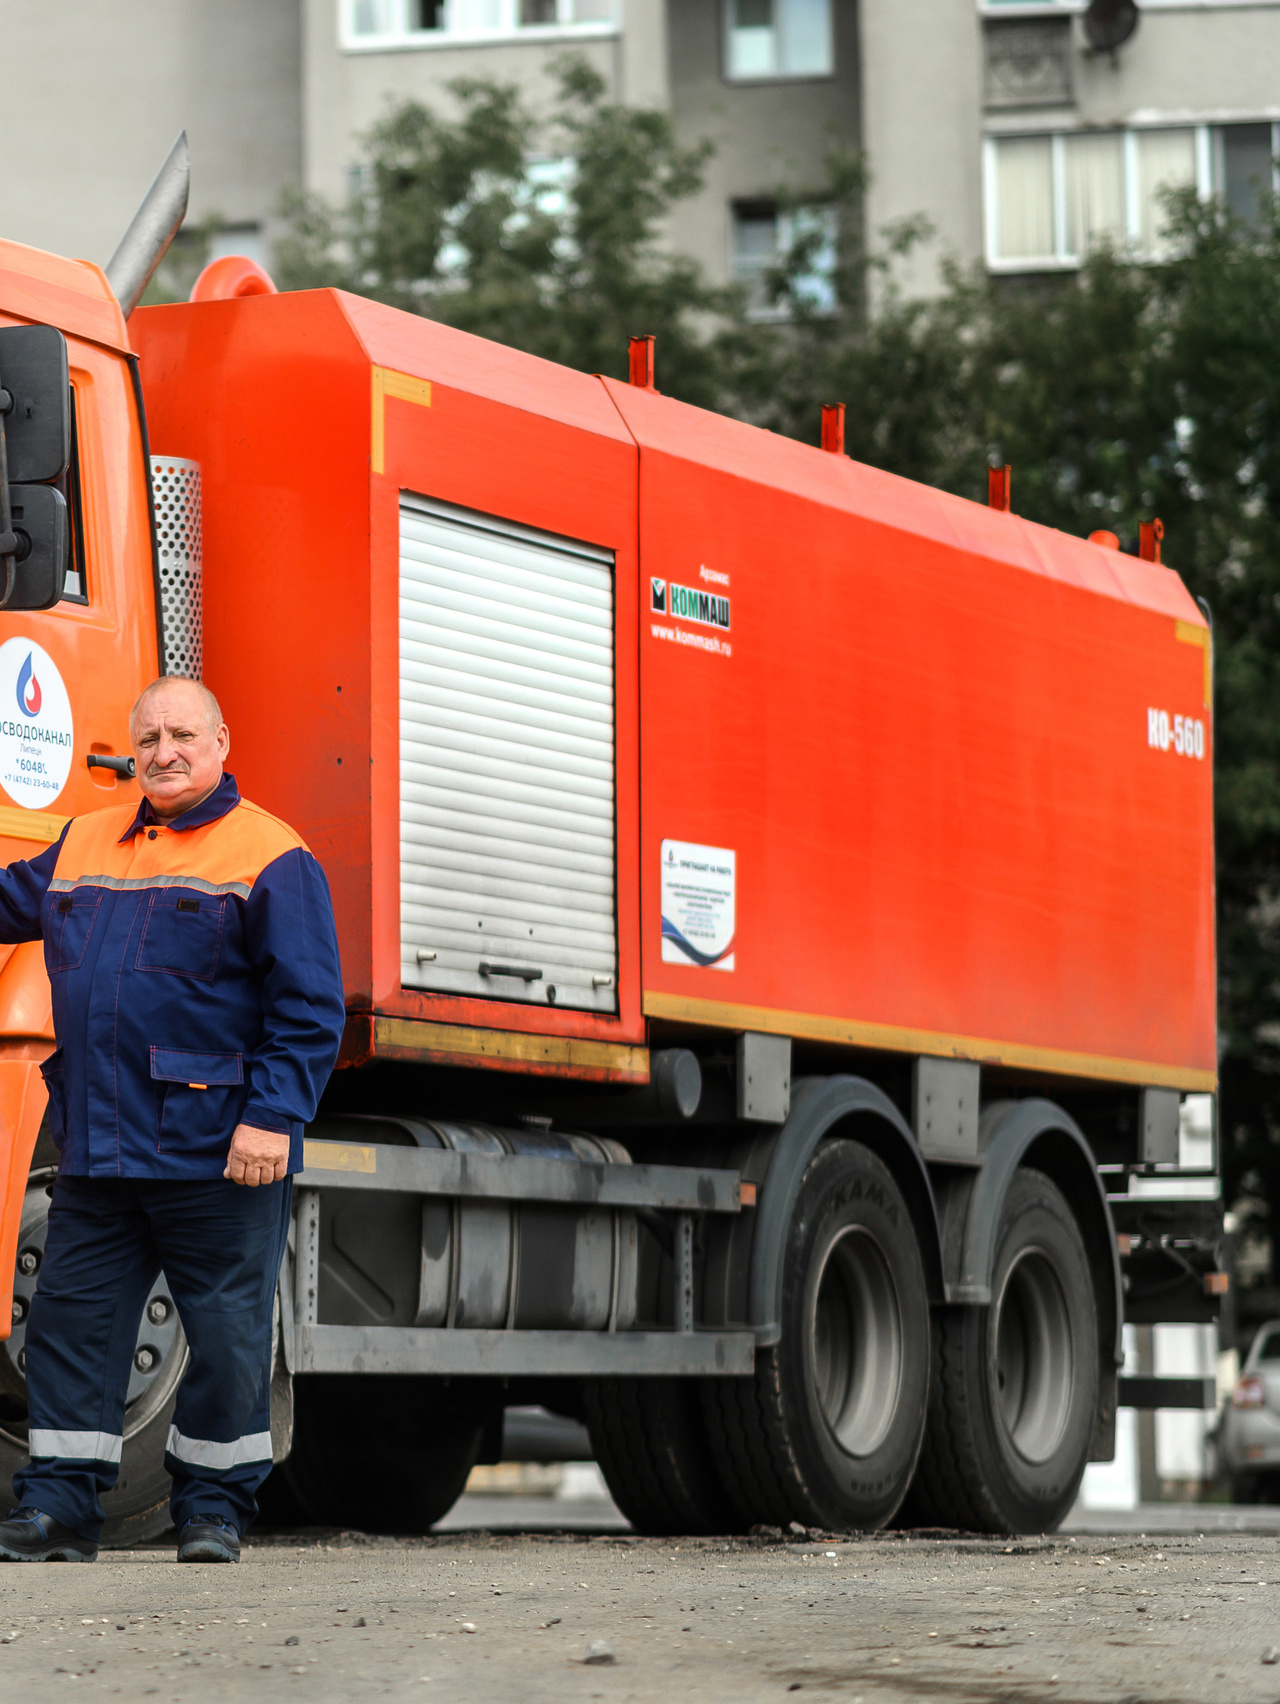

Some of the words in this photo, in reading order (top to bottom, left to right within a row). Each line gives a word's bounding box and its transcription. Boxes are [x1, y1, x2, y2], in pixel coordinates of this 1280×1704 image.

[671, 584, 729, 628] КОММАШ
[651, 625, 731, 657] www.kommash.ru
[1147, 706, 1204, 761] КО-560
[20, 743, 43, 757] Липецк
[5, 773, 12, 782] +7
[13, 775, 32, 786] (4742)
[33, 779, 59, 790] 23-60-48
